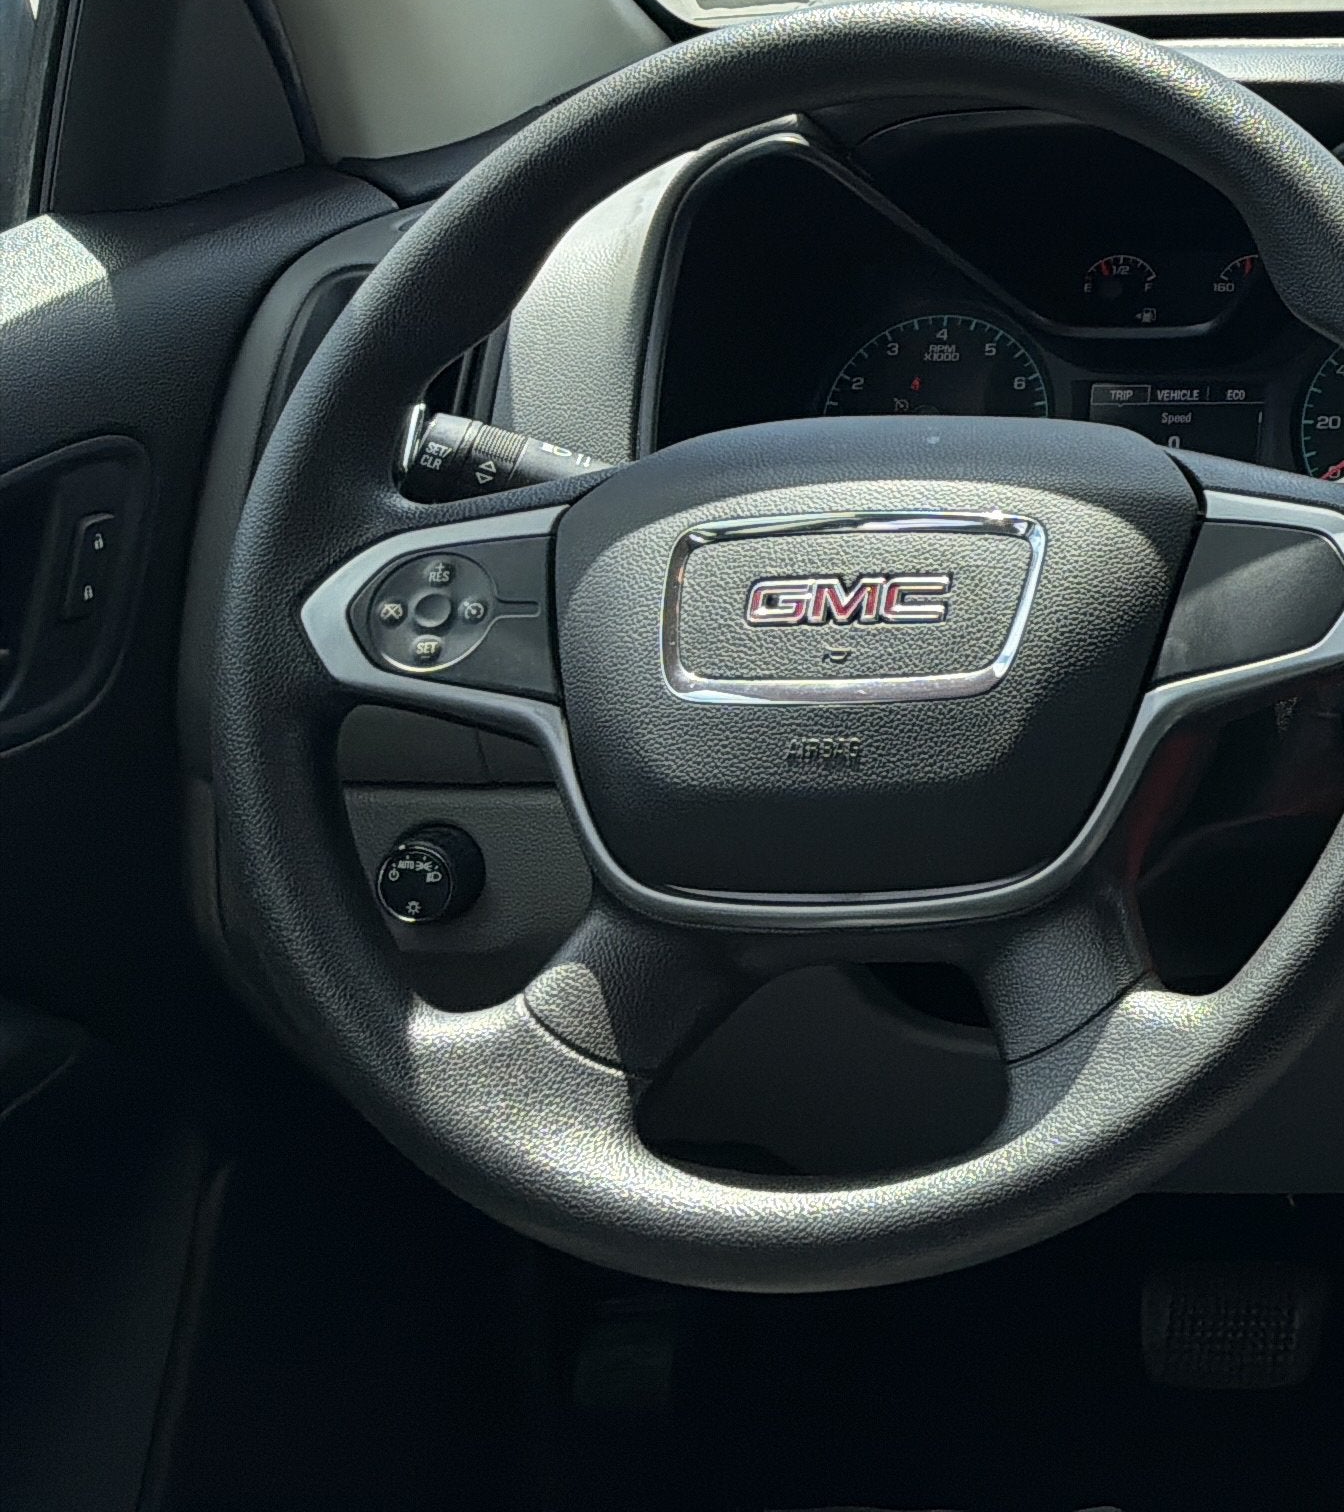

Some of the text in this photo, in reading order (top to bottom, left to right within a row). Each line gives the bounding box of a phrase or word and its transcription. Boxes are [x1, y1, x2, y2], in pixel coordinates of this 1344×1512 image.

[1083, 283, 1092, 293] E
[1144, 282, 1153, 293] F
[936, 328, 948, 341] 4
[886, 343, 899, 356] 3
[928, 345, 956, 353] RPM
[985, 343, 997, 356] 5
[851, 377, 865, 391] 2
[1013, 376, 1026, 390] 6
[1109, 389, 1134, 401] TRIP
[1156, 389, 1200, 401] VEHICLE
[1225, 389, 1246, 400] ECO
[1161, 412, 1192, 425] Speed
[1315, 415, 1342, 430] 20
[425, 441, 452, 457] SET/
[420, 455, 442, 471] CLR
[428, 570, 450, 582] RES
[745, 573, 953, 628] GMC
[416, 641, 439, 655] SET
[397, 859, 415, 871] AUTO
